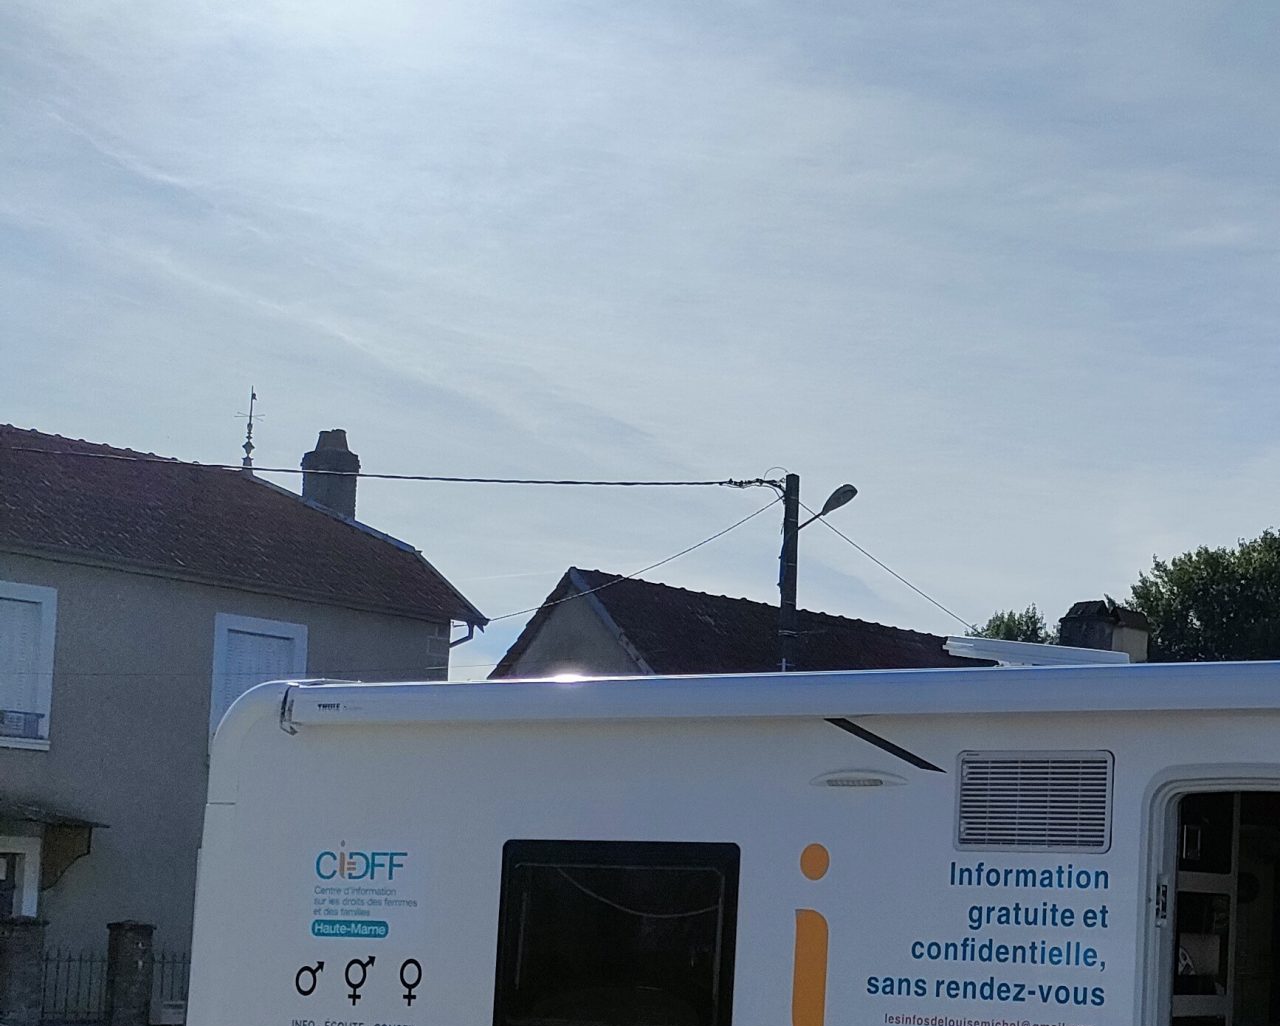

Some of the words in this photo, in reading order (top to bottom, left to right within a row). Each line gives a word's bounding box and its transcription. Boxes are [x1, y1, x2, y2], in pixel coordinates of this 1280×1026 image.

[950, 861, 1110, 890] Information
[313, 885, 342, 896] Centre
[343, 886, 397, 897] d'information
[342, 898, 365, 907] droits
[366, 899, 382, 907] des
[384, 898, 418, 908] femmes
[314, 922, 386, 936] Haute-Marne
[967, 903, 1076, 931] gratuite
[1082, 904, 1109, 929] et
[911, 938, 1107, 973] confidentielle,
[866, 976, 928, 998] sans
[934, 976, 1106, 1007] rendez-vous
